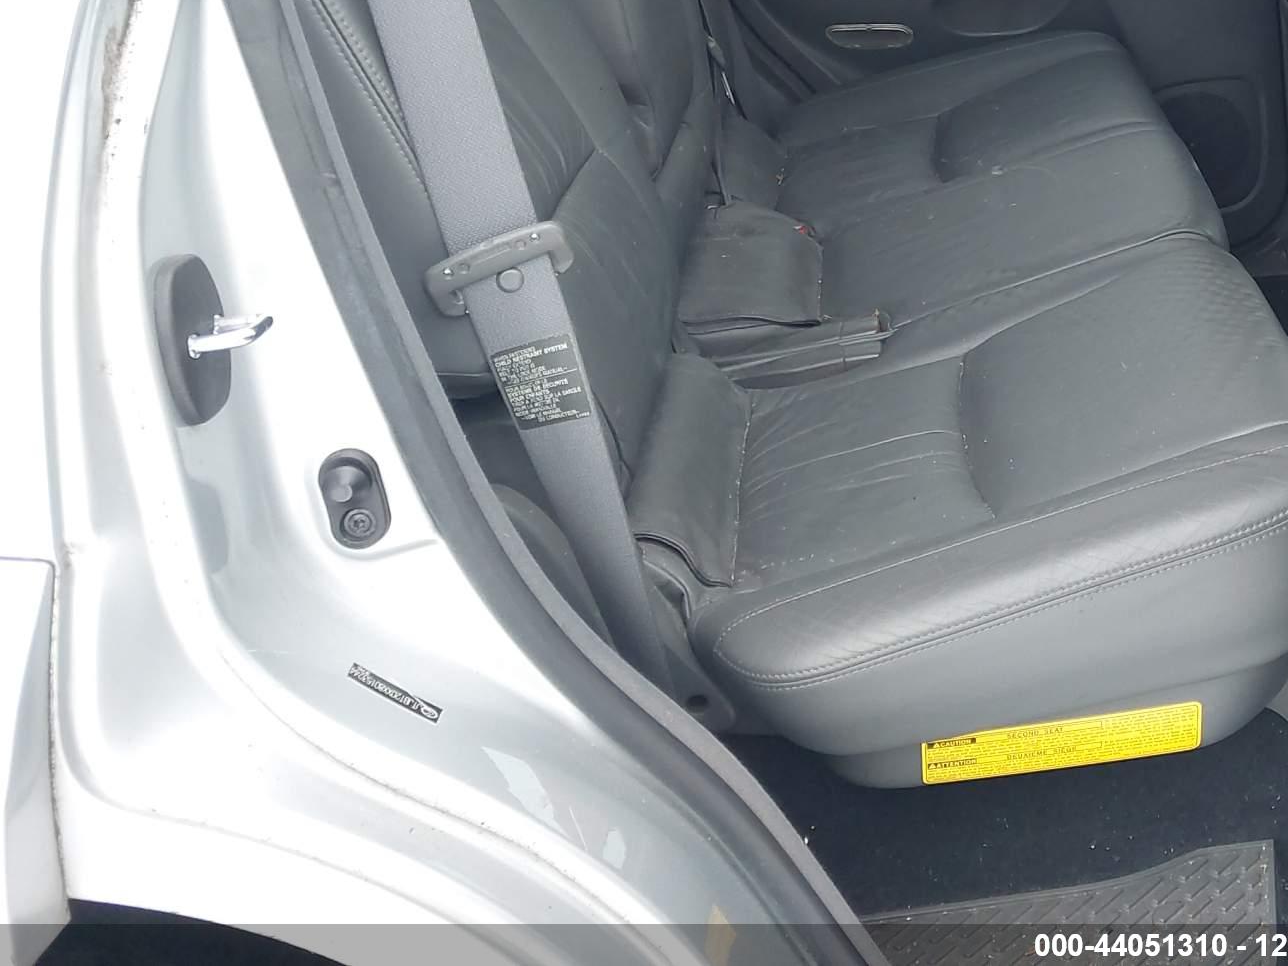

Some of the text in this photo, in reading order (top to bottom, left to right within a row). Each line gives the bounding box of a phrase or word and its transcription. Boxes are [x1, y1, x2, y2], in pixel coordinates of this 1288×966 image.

[544, 343, 568, 355] SYSTEM
[1007, 727, 1063, 739] SECOND SEAT
[940, 738, 972, 748] CAUTION
[937, 758, 977, 768] ATTENTION
